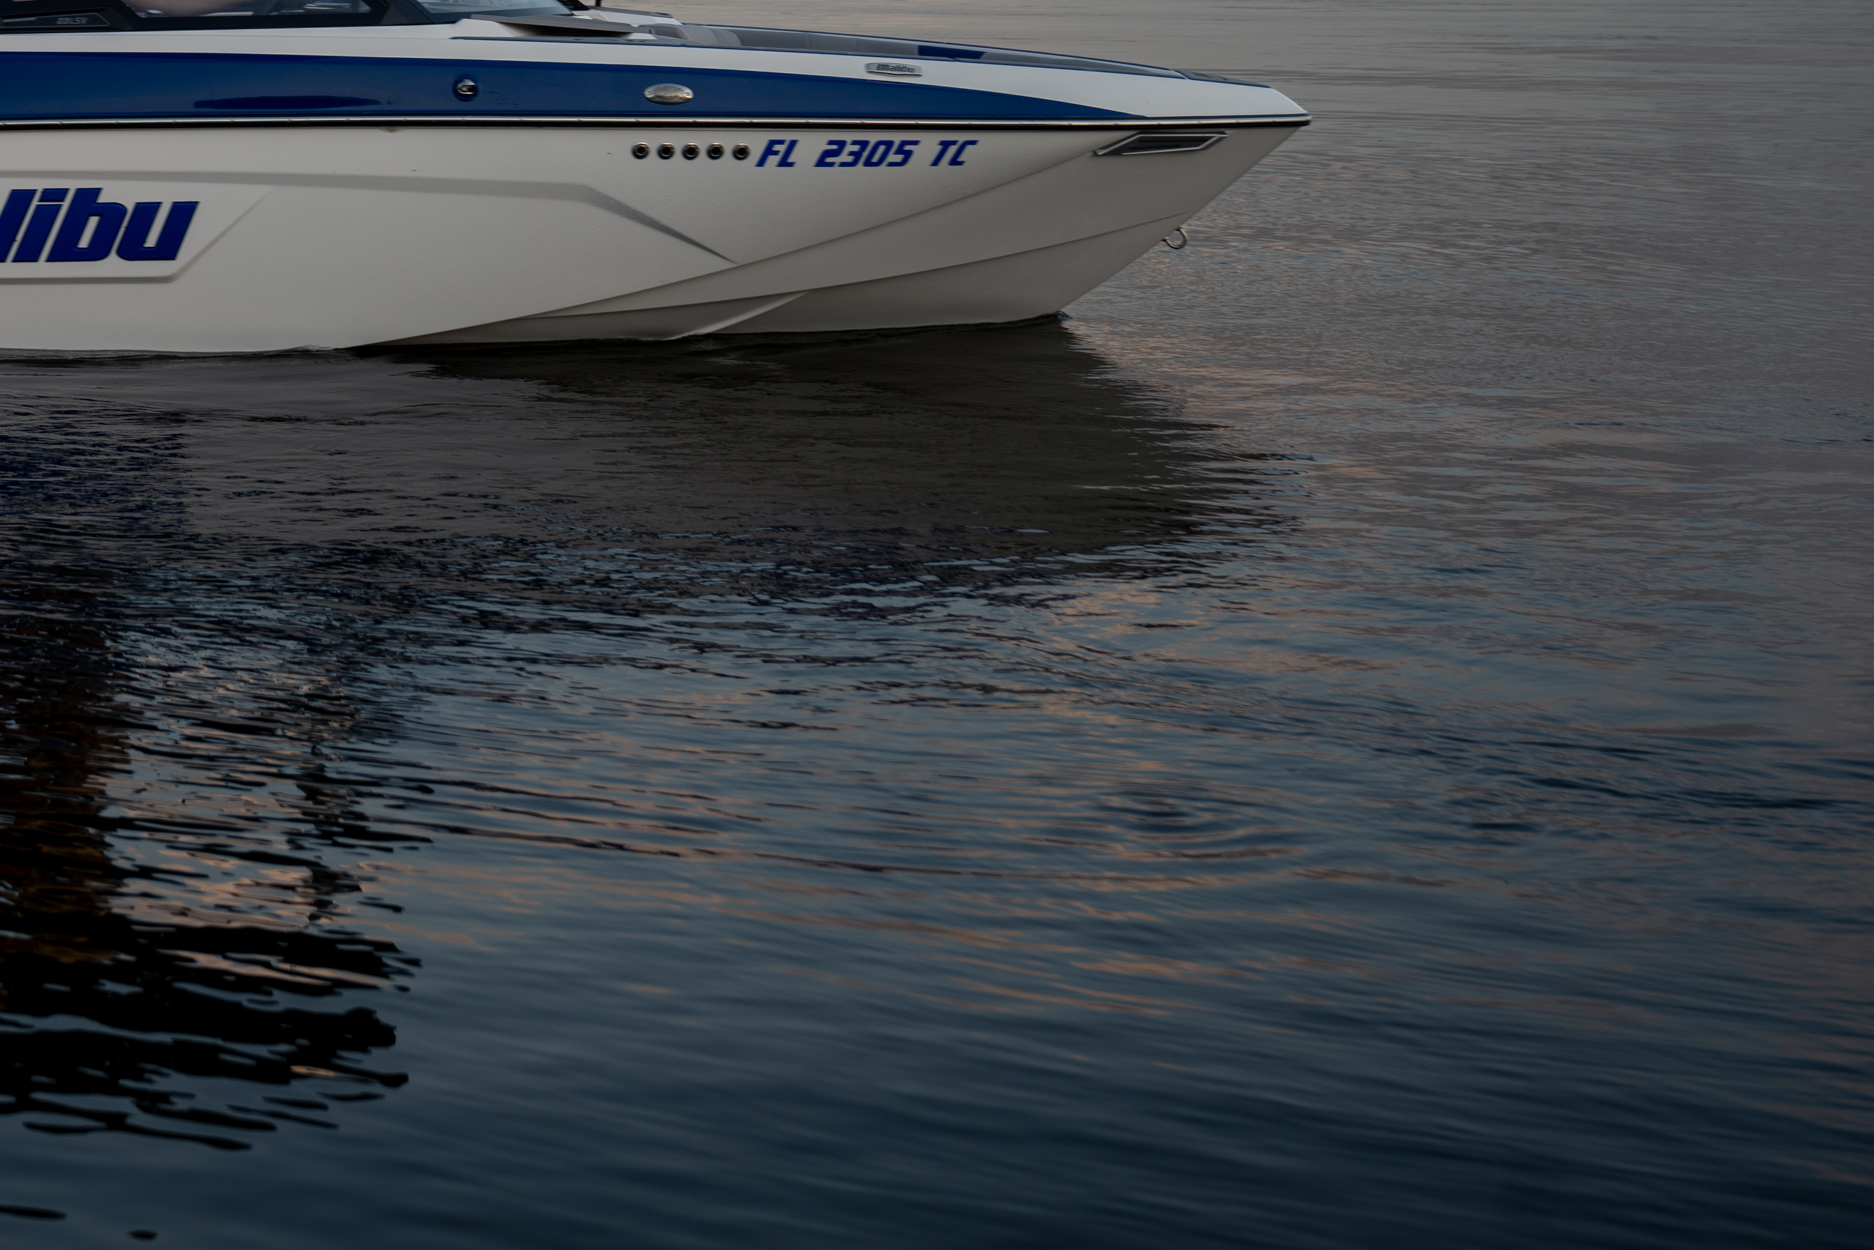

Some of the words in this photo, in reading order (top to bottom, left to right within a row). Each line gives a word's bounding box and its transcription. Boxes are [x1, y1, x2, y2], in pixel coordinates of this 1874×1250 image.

[755, 139, 799, 168] FL
[813, 139, 922, 168] 2305
[928, 139, 980, 167] TC
